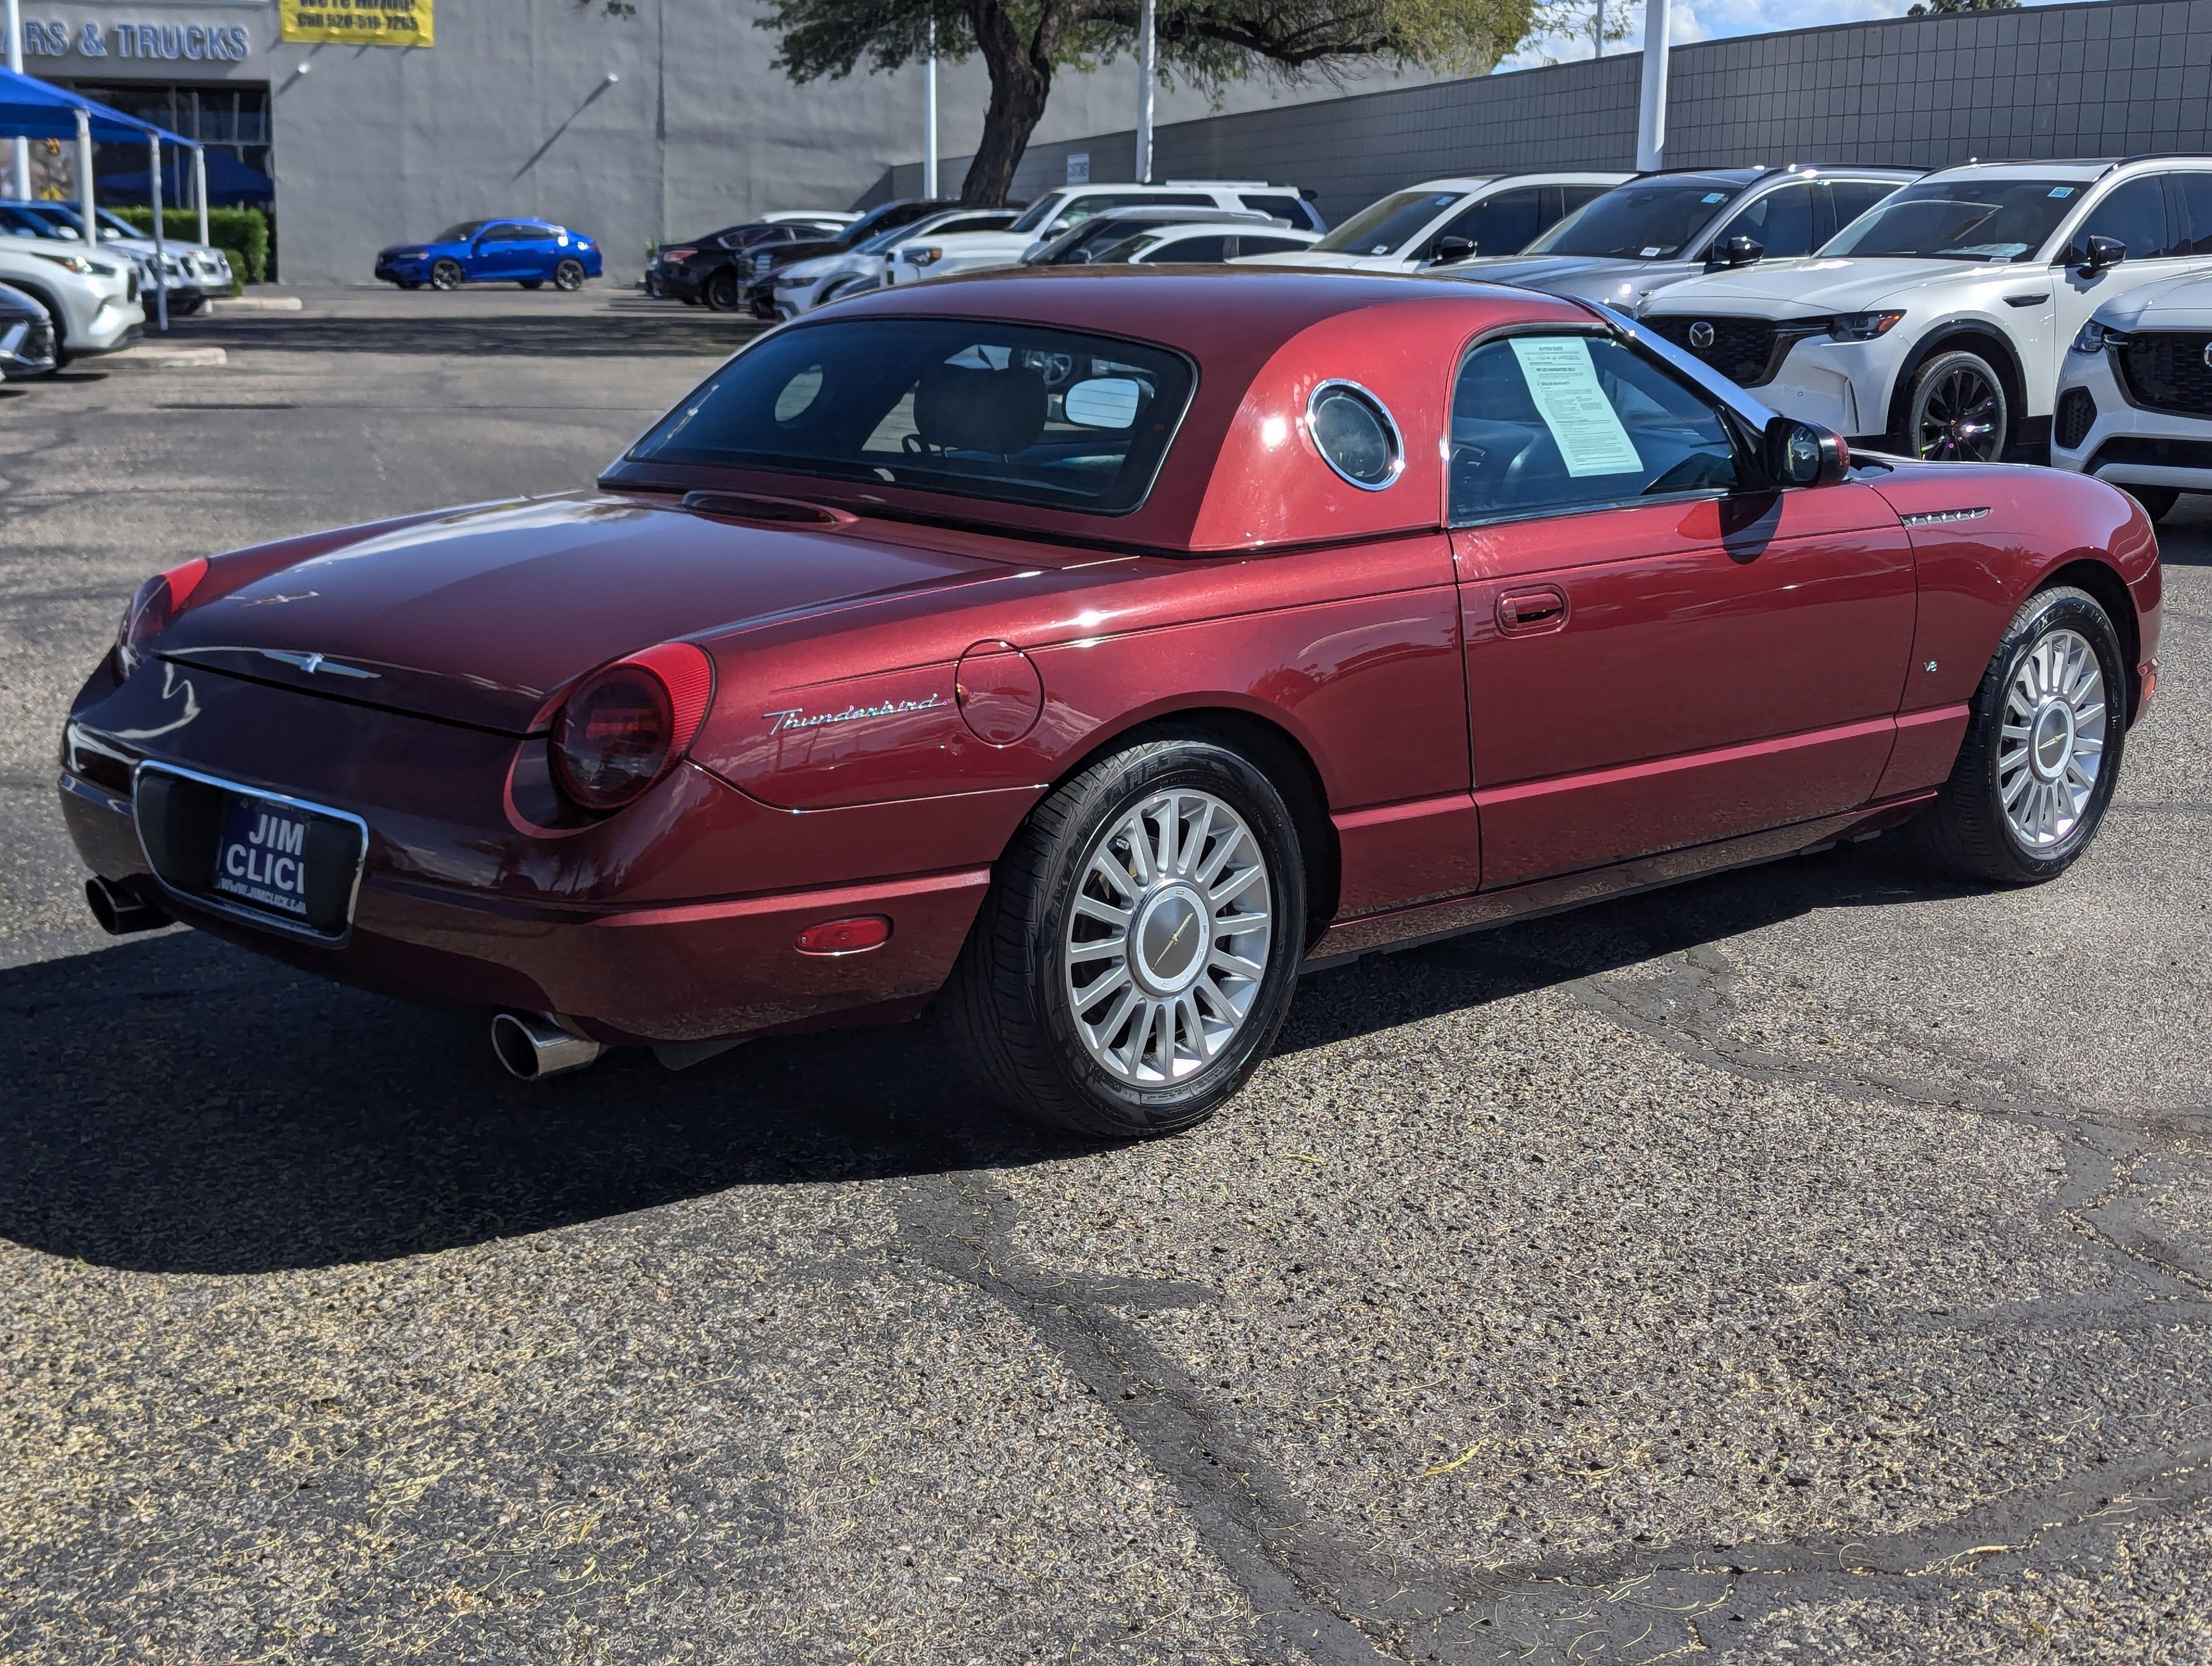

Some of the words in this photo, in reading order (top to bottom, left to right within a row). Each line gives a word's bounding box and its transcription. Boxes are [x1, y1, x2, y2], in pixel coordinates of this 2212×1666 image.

[0, 20, 69, 56] RS
[79, 20, 108, 56] &
[113, 21, 250, 61] TRUCKS
[761, 693, 948, 738] Thunderbird
[249, 813, 305, 856] JIM
